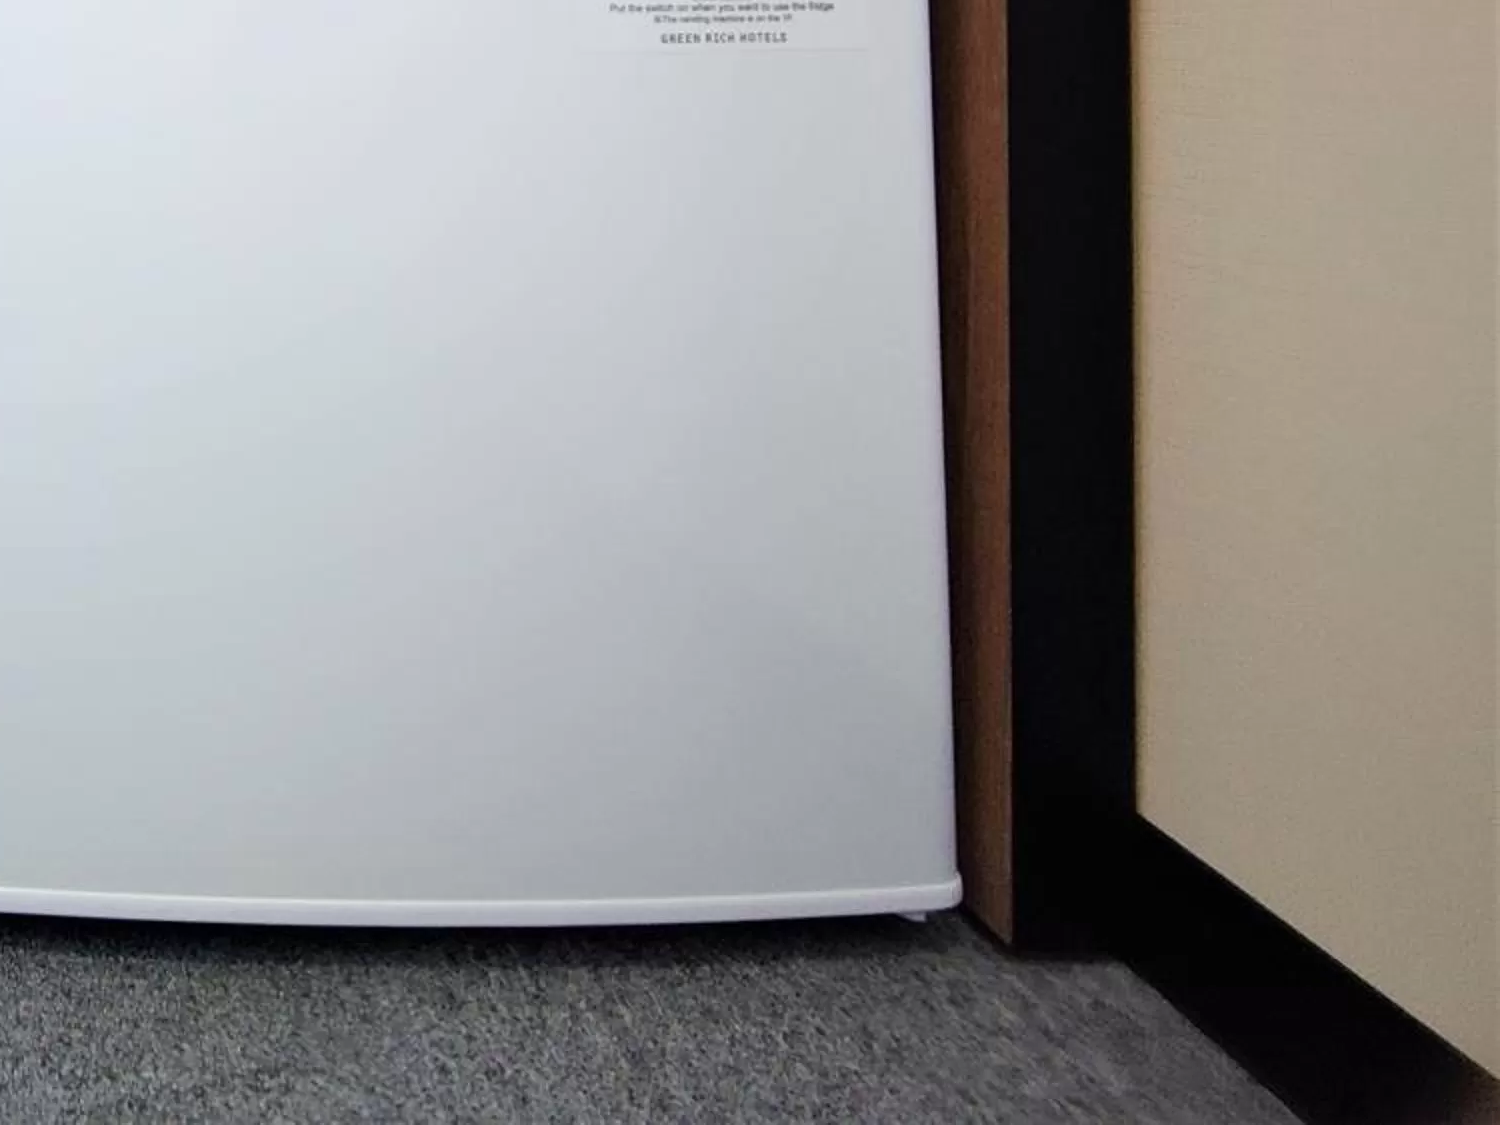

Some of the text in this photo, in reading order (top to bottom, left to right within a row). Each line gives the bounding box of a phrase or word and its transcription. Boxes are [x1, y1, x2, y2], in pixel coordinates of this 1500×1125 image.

[660, 32, 788, 44] GREEN RICH HOTELS
